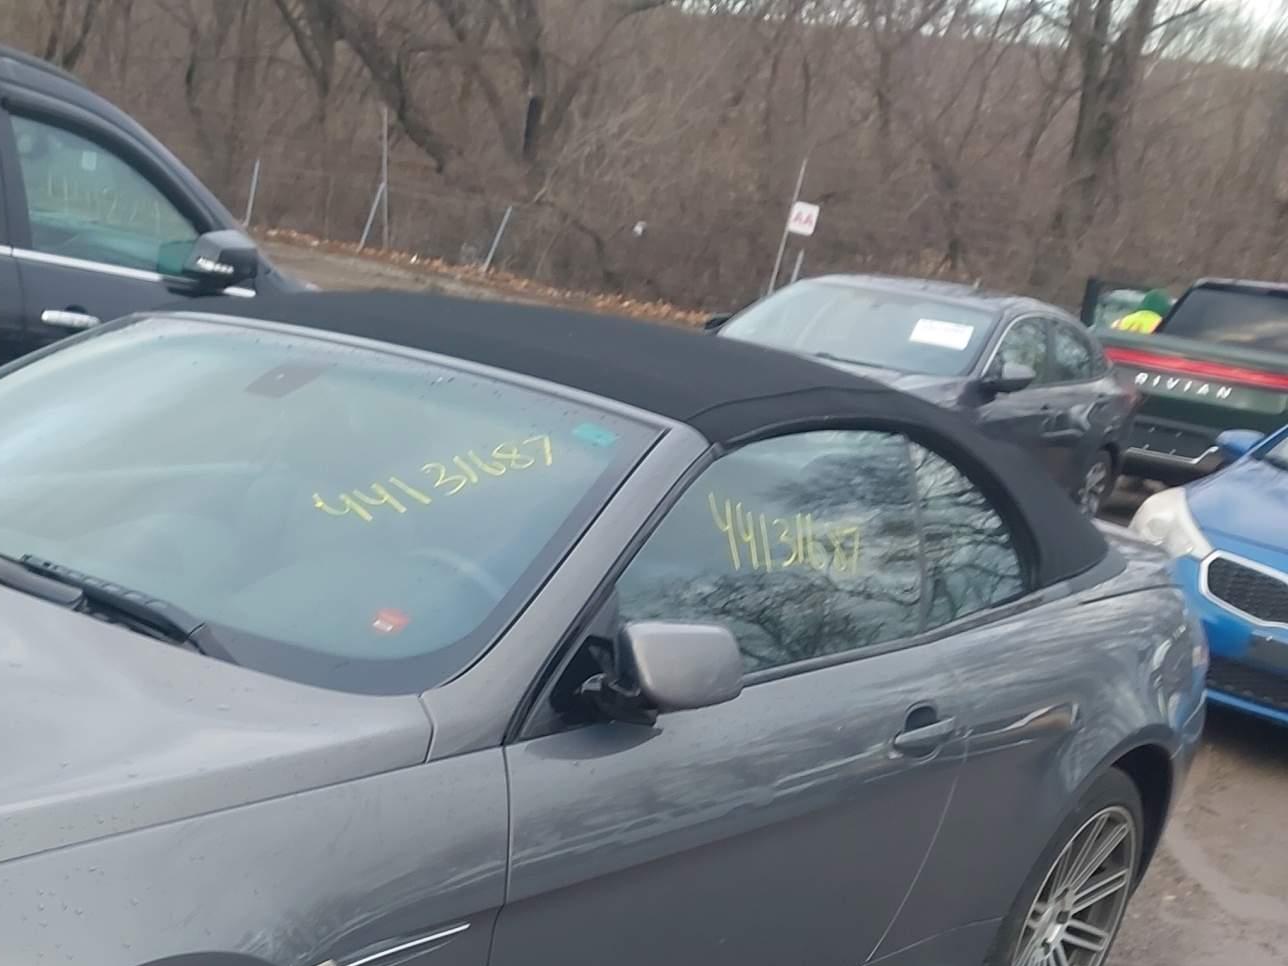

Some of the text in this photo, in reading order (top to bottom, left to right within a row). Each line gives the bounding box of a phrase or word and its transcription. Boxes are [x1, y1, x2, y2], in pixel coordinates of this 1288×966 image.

[1134, 372, 1232, 400] RIVIAN
[312, 434, 553, 522] 44131687
[708, 492, 861, 575] 44131687
